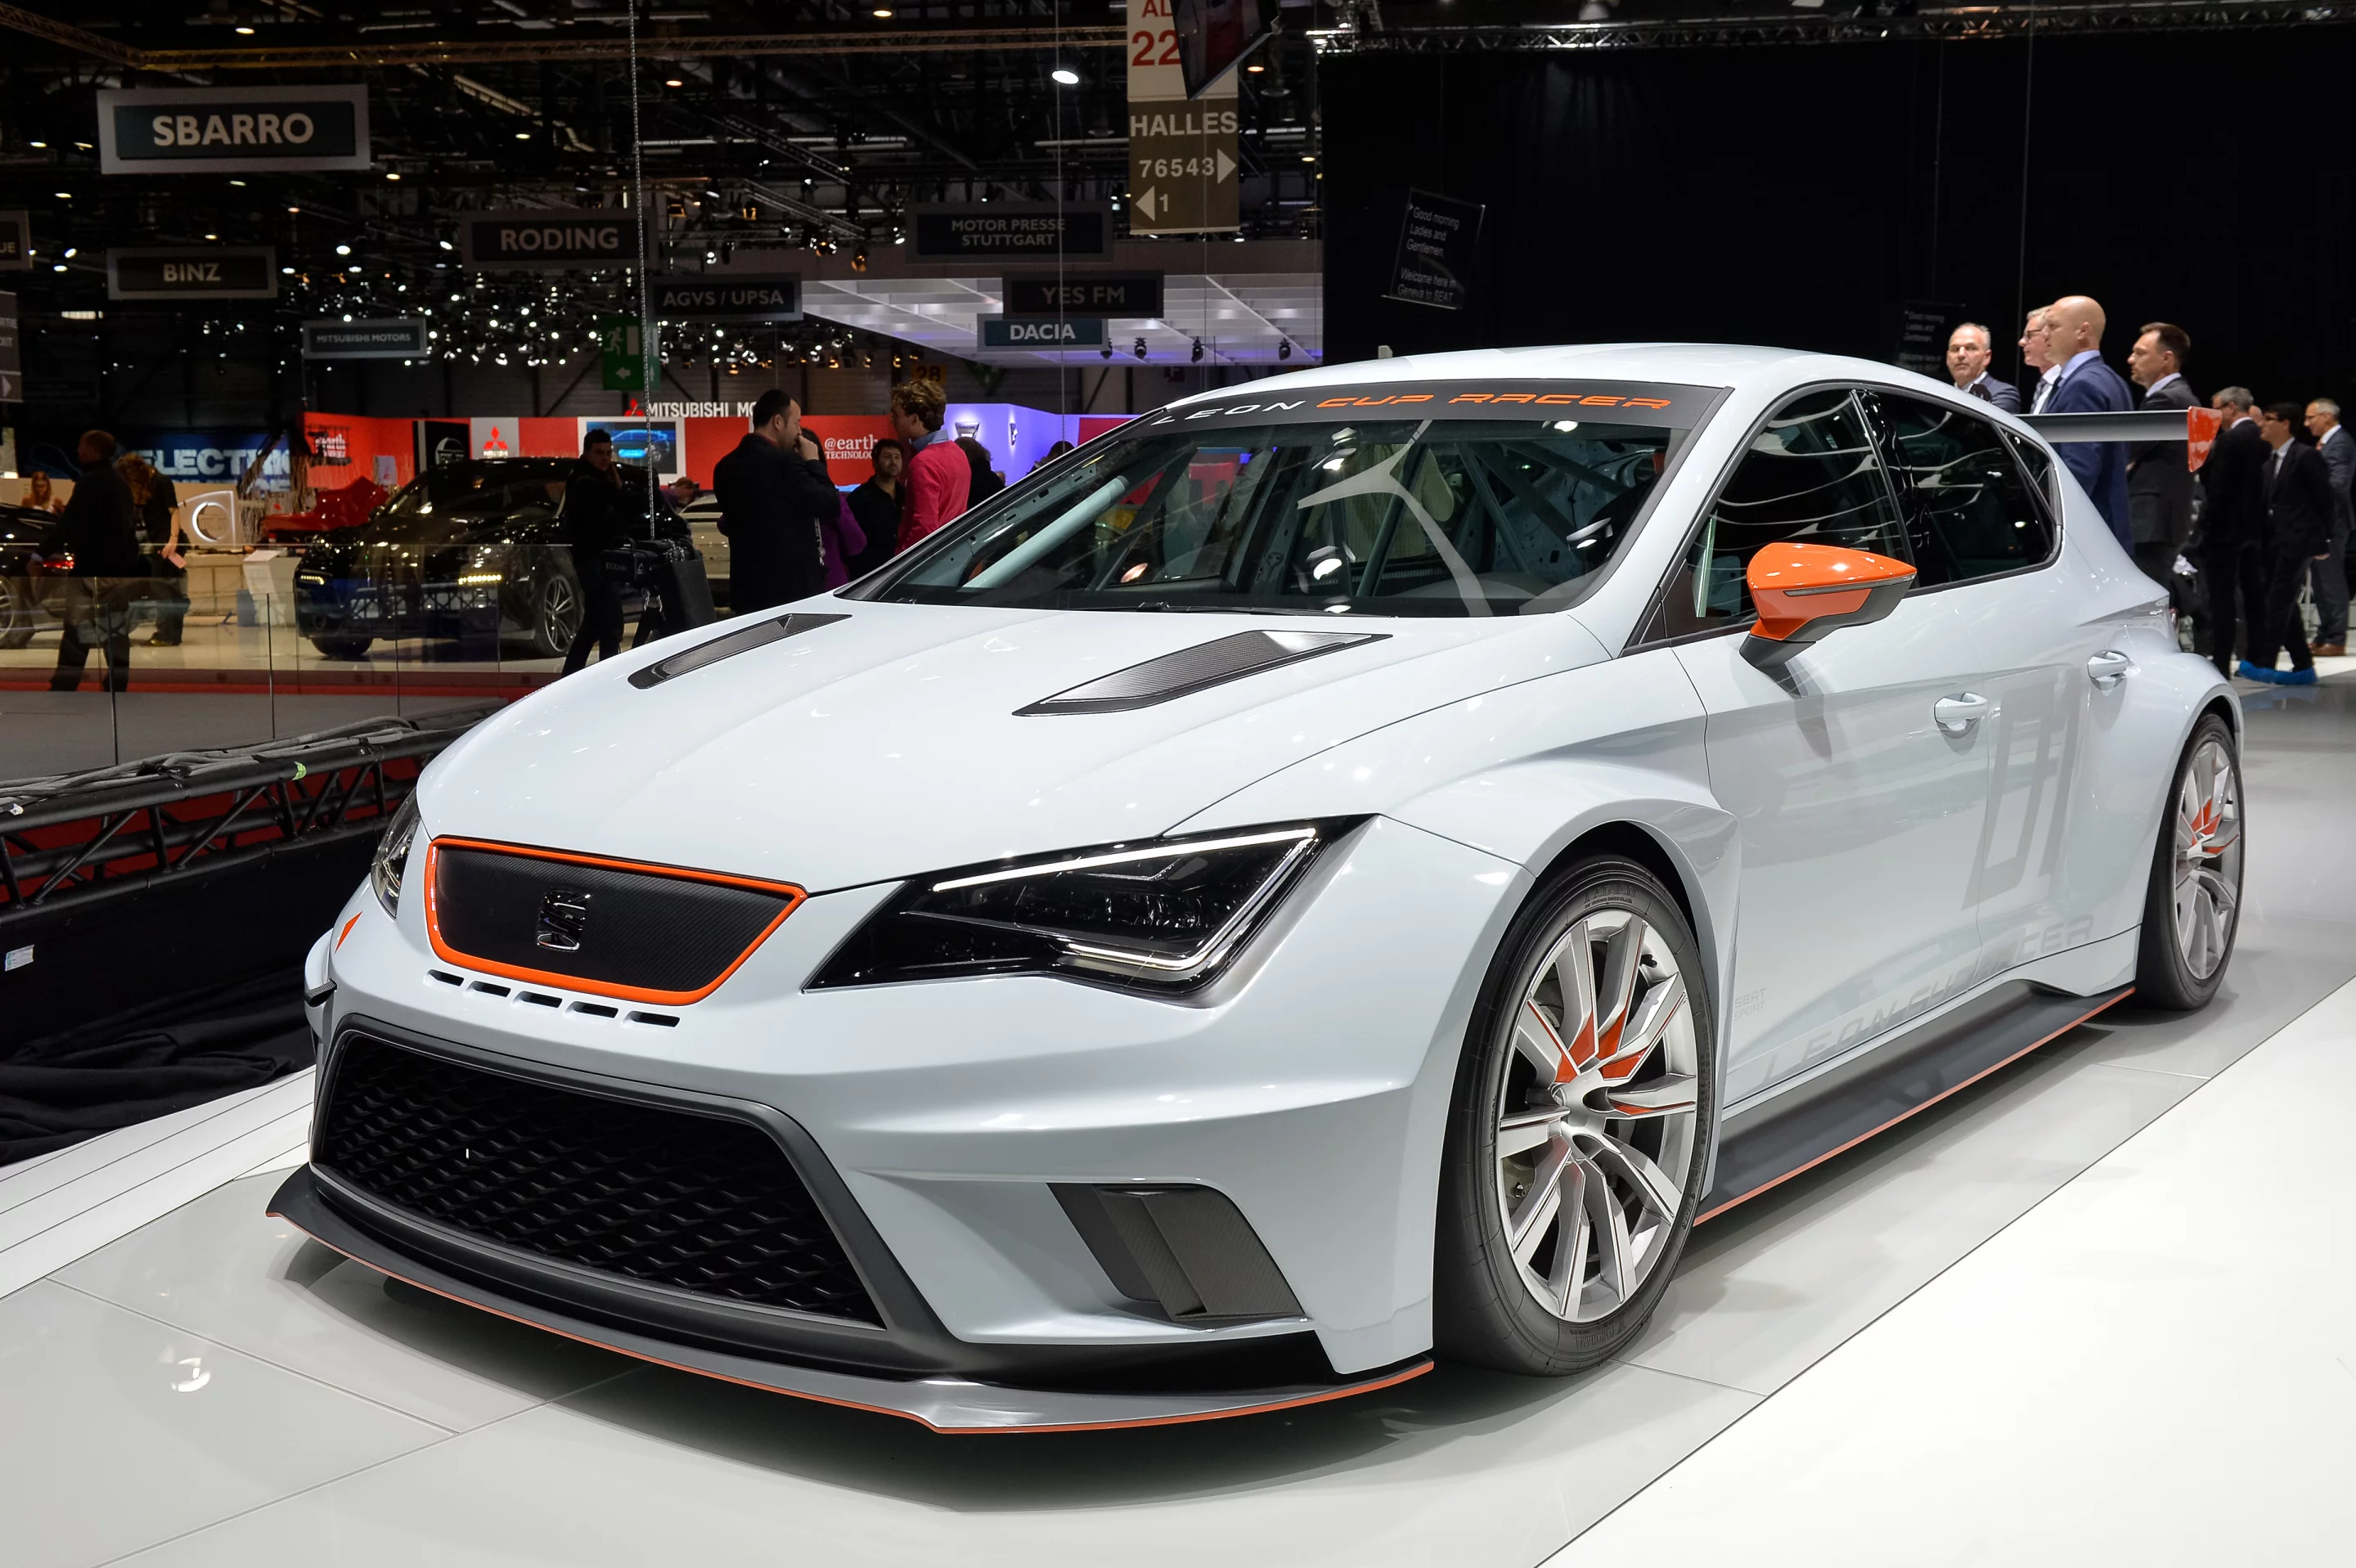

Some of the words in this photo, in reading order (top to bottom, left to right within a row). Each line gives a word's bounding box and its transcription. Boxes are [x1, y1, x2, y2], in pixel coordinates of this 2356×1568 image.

[152, 112, 314, 146] SBARRO
[1131, 111, 1238, 137] HALLES
[1159, 194, 1169, 213] 1
[952, 219, 1006, 231] MOTOR
[1011, 218, 1066, 231] PRESSE
[501, 227, 619, 251] RODING
[962, 234, 1055, 246] STUTTGART
[164, 263, 222, 282] BINZ
[663, 291, 717, 307] AGVS
[731, 290, 784, 305] UPSA
[1041, 287, 1085, 304] YES
[1093, 287, 1125, 303] FM
[317, 333, 369, 343] MITSUBISHI
[371, 333, 411, 342] MOTORS
[1009, 324, 1076, 340] DACIA
[649, 402, 729, 418] MITSUBISHI
[1150, 400, 1306, 425] LEON
[1316, 394, 1434, 407] CUP
[1448, 393, 1671, 409] RACER
[825, 434, 878, 451] @earth
[1734, 987, 1767, 1009] SEAT
[1733, 1000, 1766, 1021] SPORT
